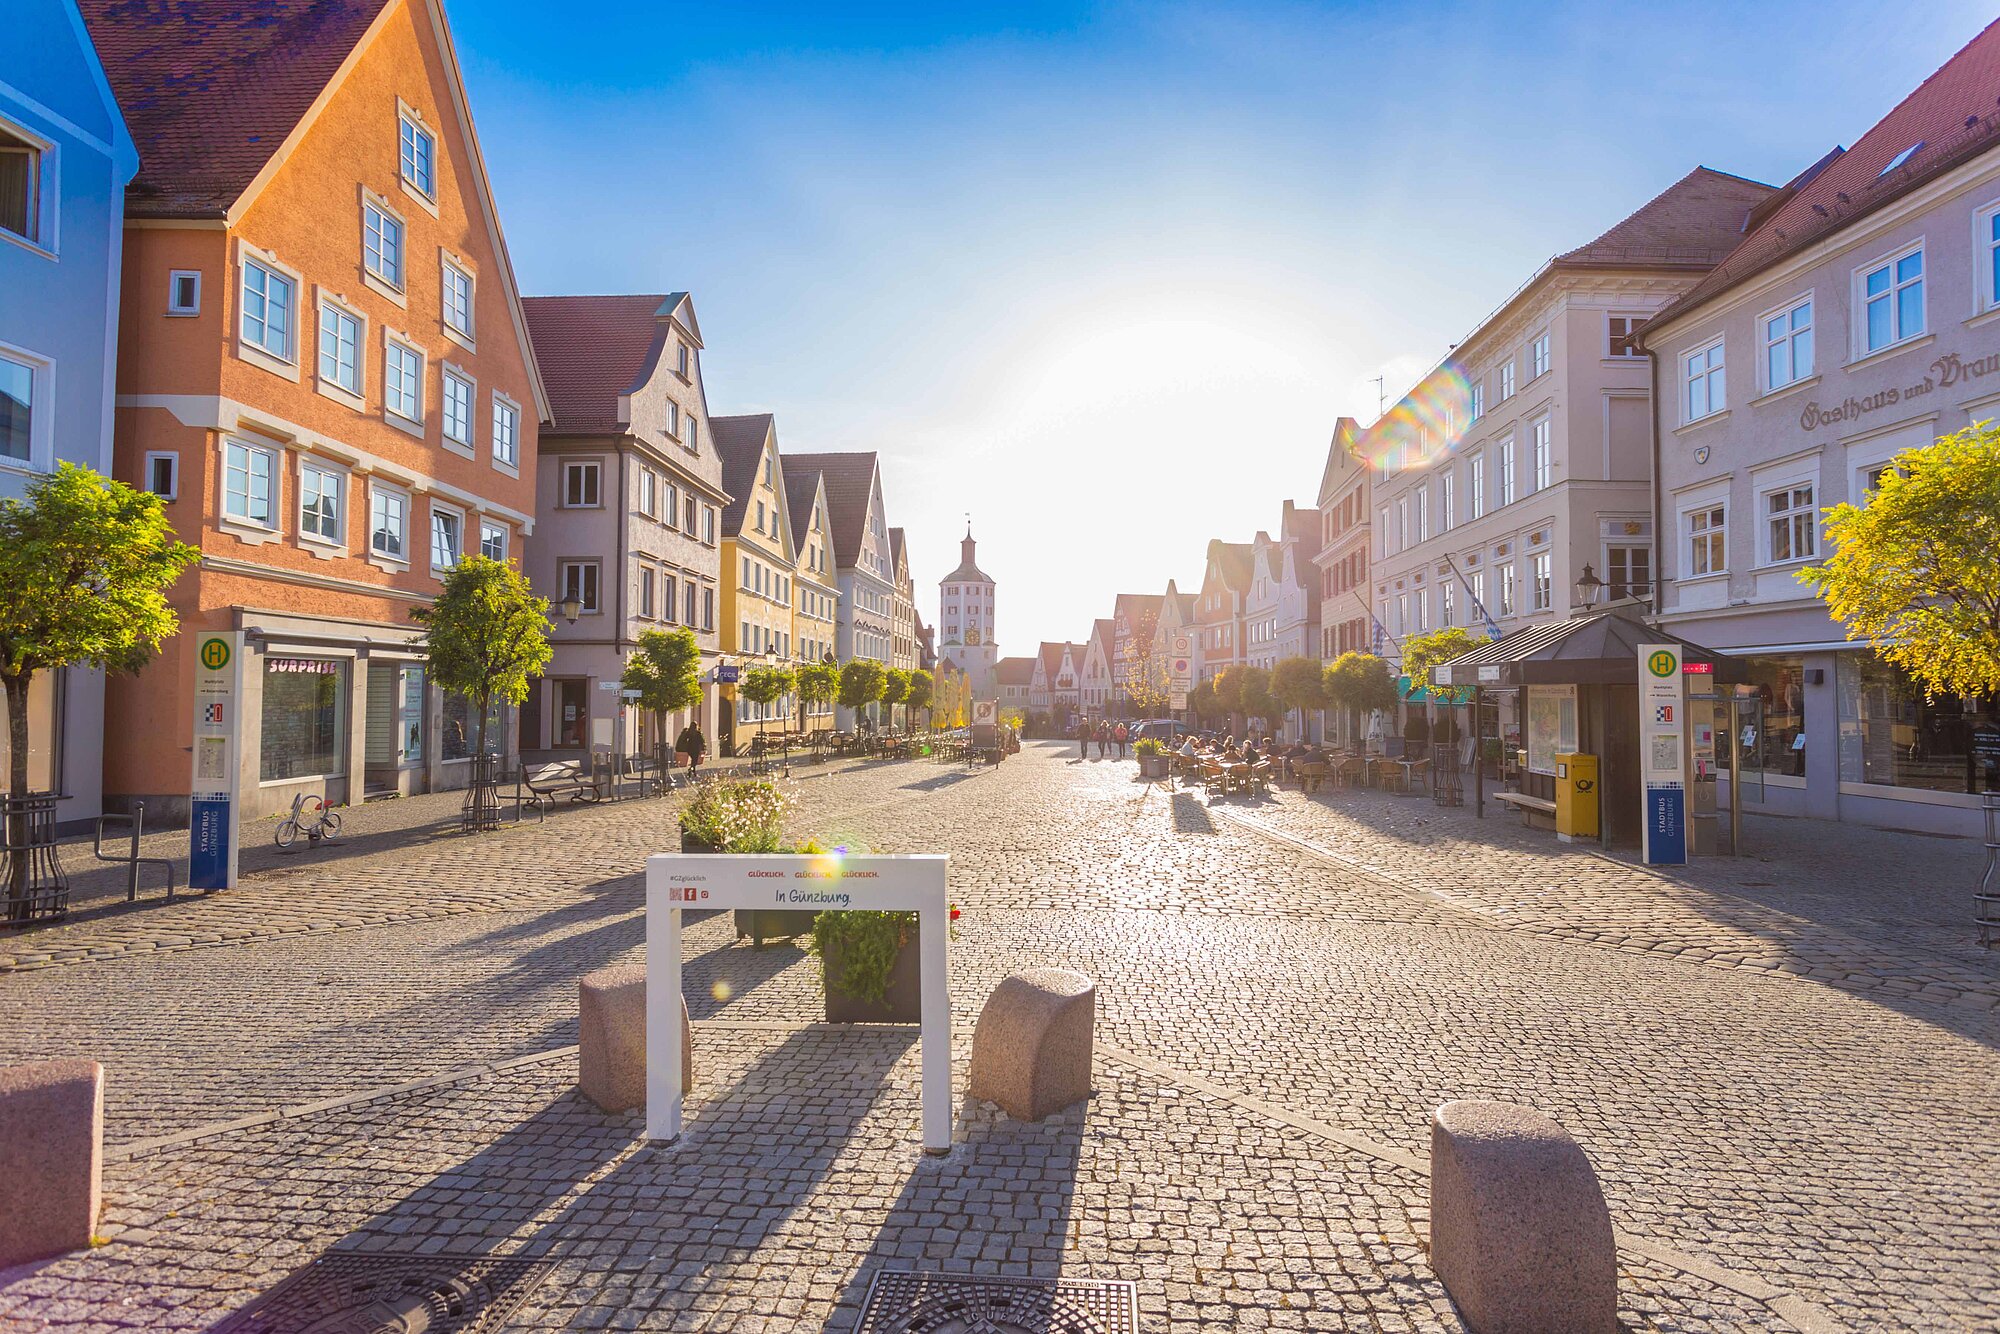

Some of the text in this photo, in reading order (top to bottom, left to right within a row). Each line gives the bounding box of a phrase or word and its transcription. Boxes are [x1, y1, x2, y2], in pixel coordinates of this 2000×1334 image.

[1801, 388, 1900, 431] Gasthaus
[1904, 376, 1933, 400] und
[209, 645, 221, 663] H
[269, 659, 337, 674] SURPRISE
[1656, 656, 1669, 671] H
[1658, 797, 1666, 833] STADTBUS
[202, 810, 210, 852] STADTBUS
[748, 870, 880, 879] GLÜCKLICH. GLÜCKLICH. GLÜCKLICH.
[775, 889, 852, 908] In Günzburg.
